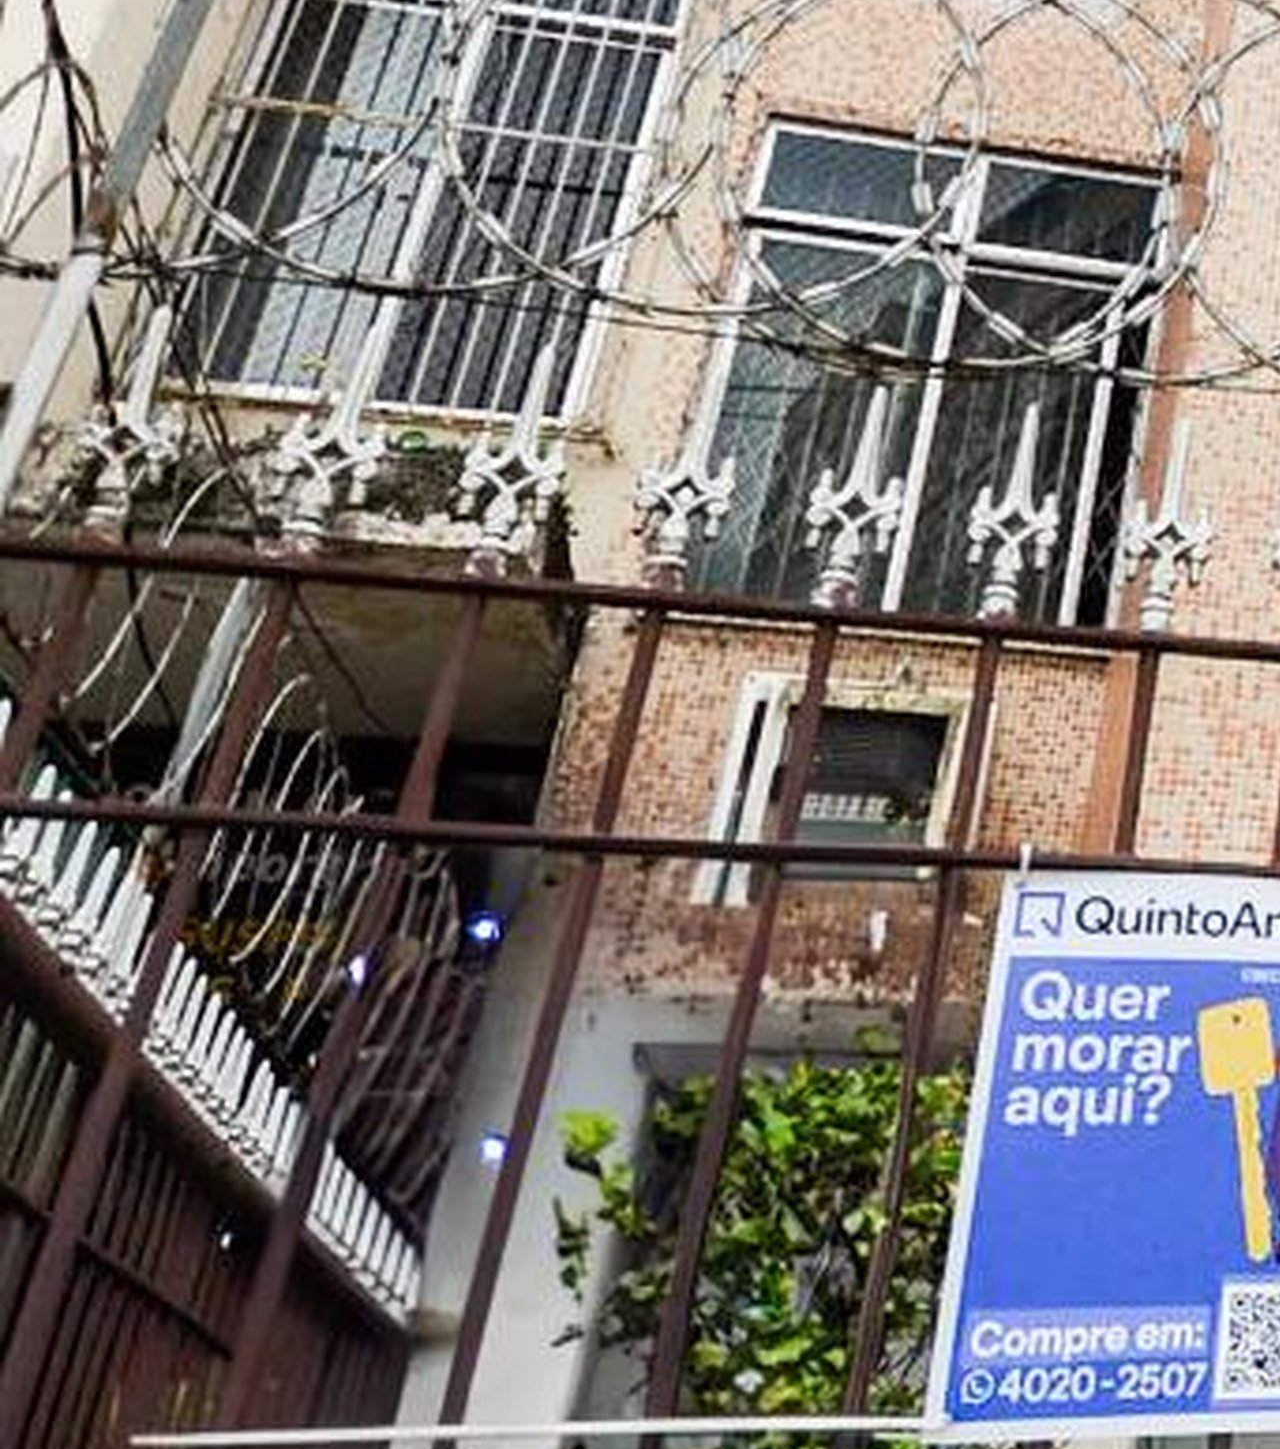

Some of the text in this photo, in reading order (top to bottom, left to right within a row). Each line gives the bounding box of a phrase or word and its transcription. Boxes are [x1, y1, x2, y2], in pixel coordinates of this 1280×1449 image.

[1020, 969, 1171, 1022] Quer
[1011, 1030, 1193, 1074] morar
[1004, 1072, 1173, 1136] aqui?
[970, 1320, 1206, 1361] Compre em:
[997, 1362, 1209, 1403] 4020-2507
